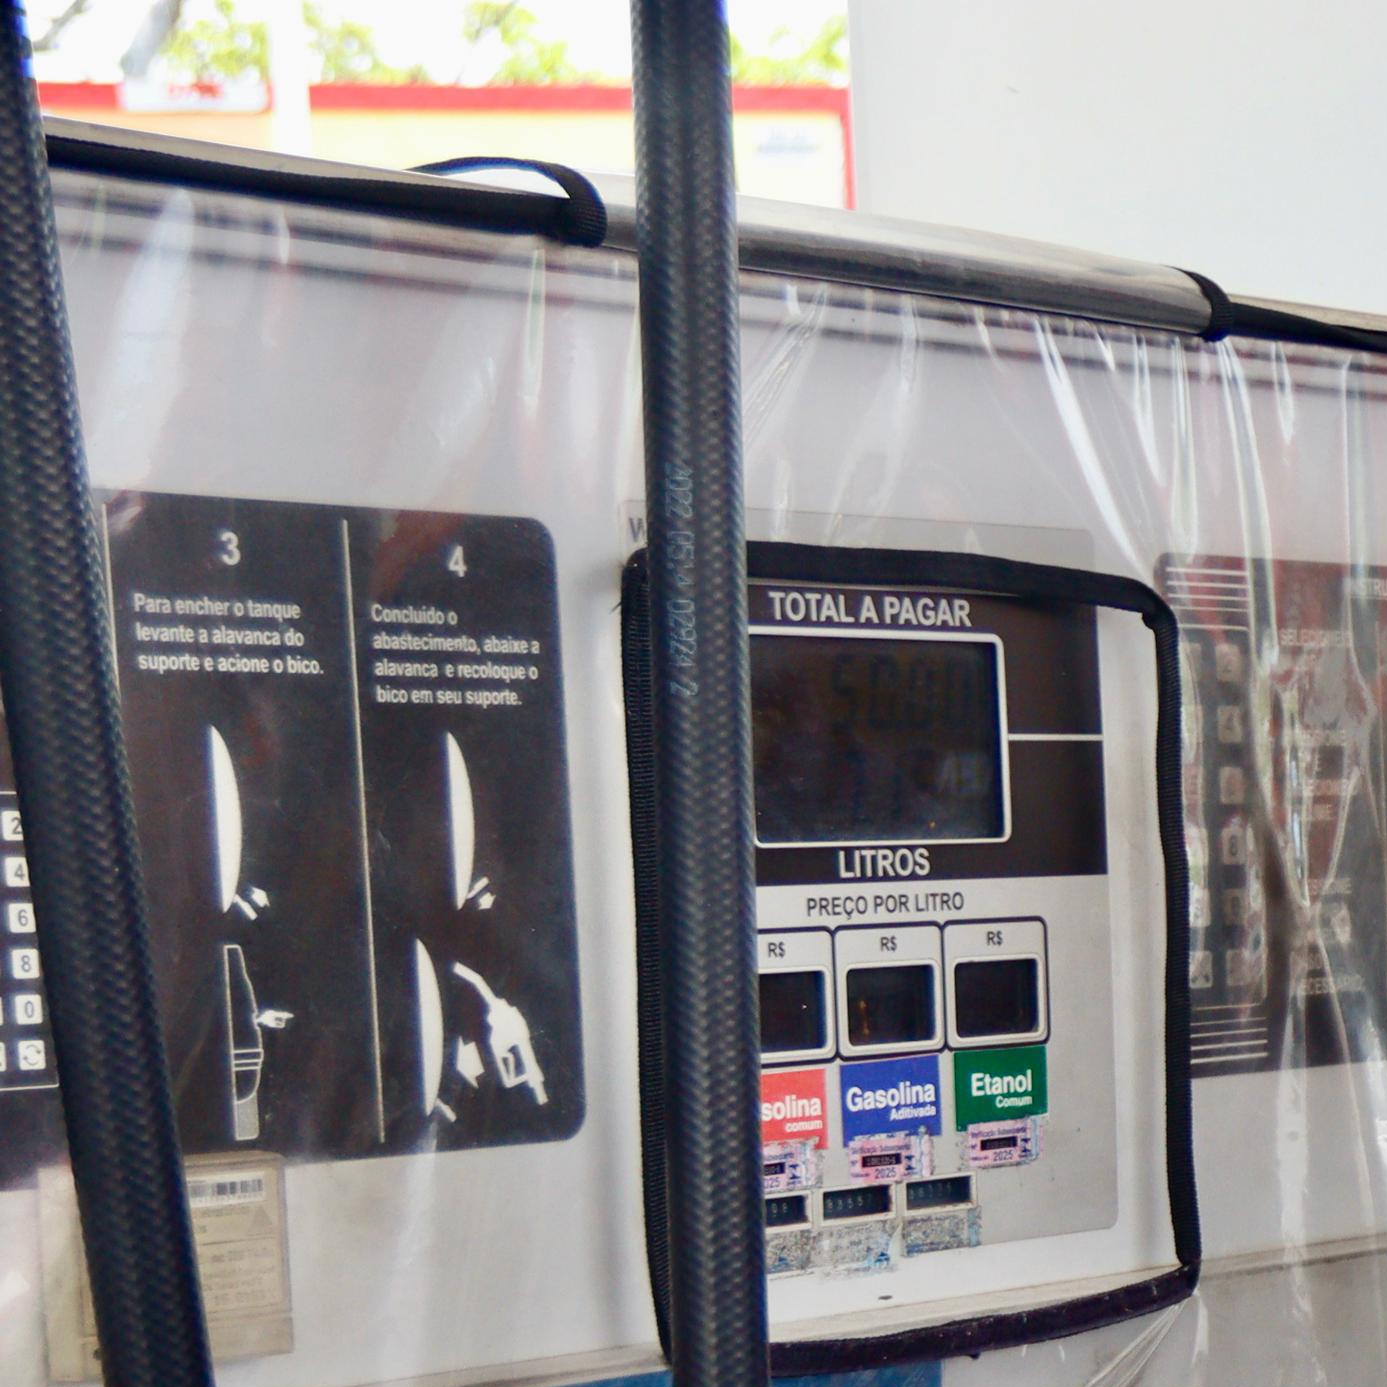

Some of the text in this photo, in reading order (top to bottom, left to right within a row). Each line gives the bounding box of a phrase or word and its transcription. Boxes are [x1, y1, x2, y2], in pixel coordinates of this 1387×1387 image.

[220, 531, 241, 566] 3
[448, 544, 468, 577] 4
[134, 593, 300, 622] Para encher o tanque
[448, 611, 458, 625] o
[769, 591, 972, 628] TOTAL A PAGAR
[135, 622, 304, 646] levante a alavanca do
[372, 631, 540, 655] abastecimento, abaixe a
[138, 654, 324, 674] suporte e acione o bico.
[375, 658, 538, 682] alavanca e recoloque o
[376, 685, 522, 708] bico em seu suporte.
[14, 863, 25, 881] 4
[838, 847, 931, 879] LITROS
[806, 891, 965, 920] PREÇO POR LITRO
[17, 909, 28, 926] 6
[767, 941, 786, 959] R$
[880, 935, 898, 953] R$
[986, 930, 1003, 947] R$
[21, 955, 31, 972] 8
[24, 1001, 34, 1018] 0
[970, 1069, 1033, 1098] Etanol
[762, 1094, 823, 1121] solina
[846, 1081, 937, 1114] Gasolina
[996, 1094, 1033, 1108] Comum
[890, 1102, 937, 1120] Aditivada
[785, 1117, 823, 1133] comum
